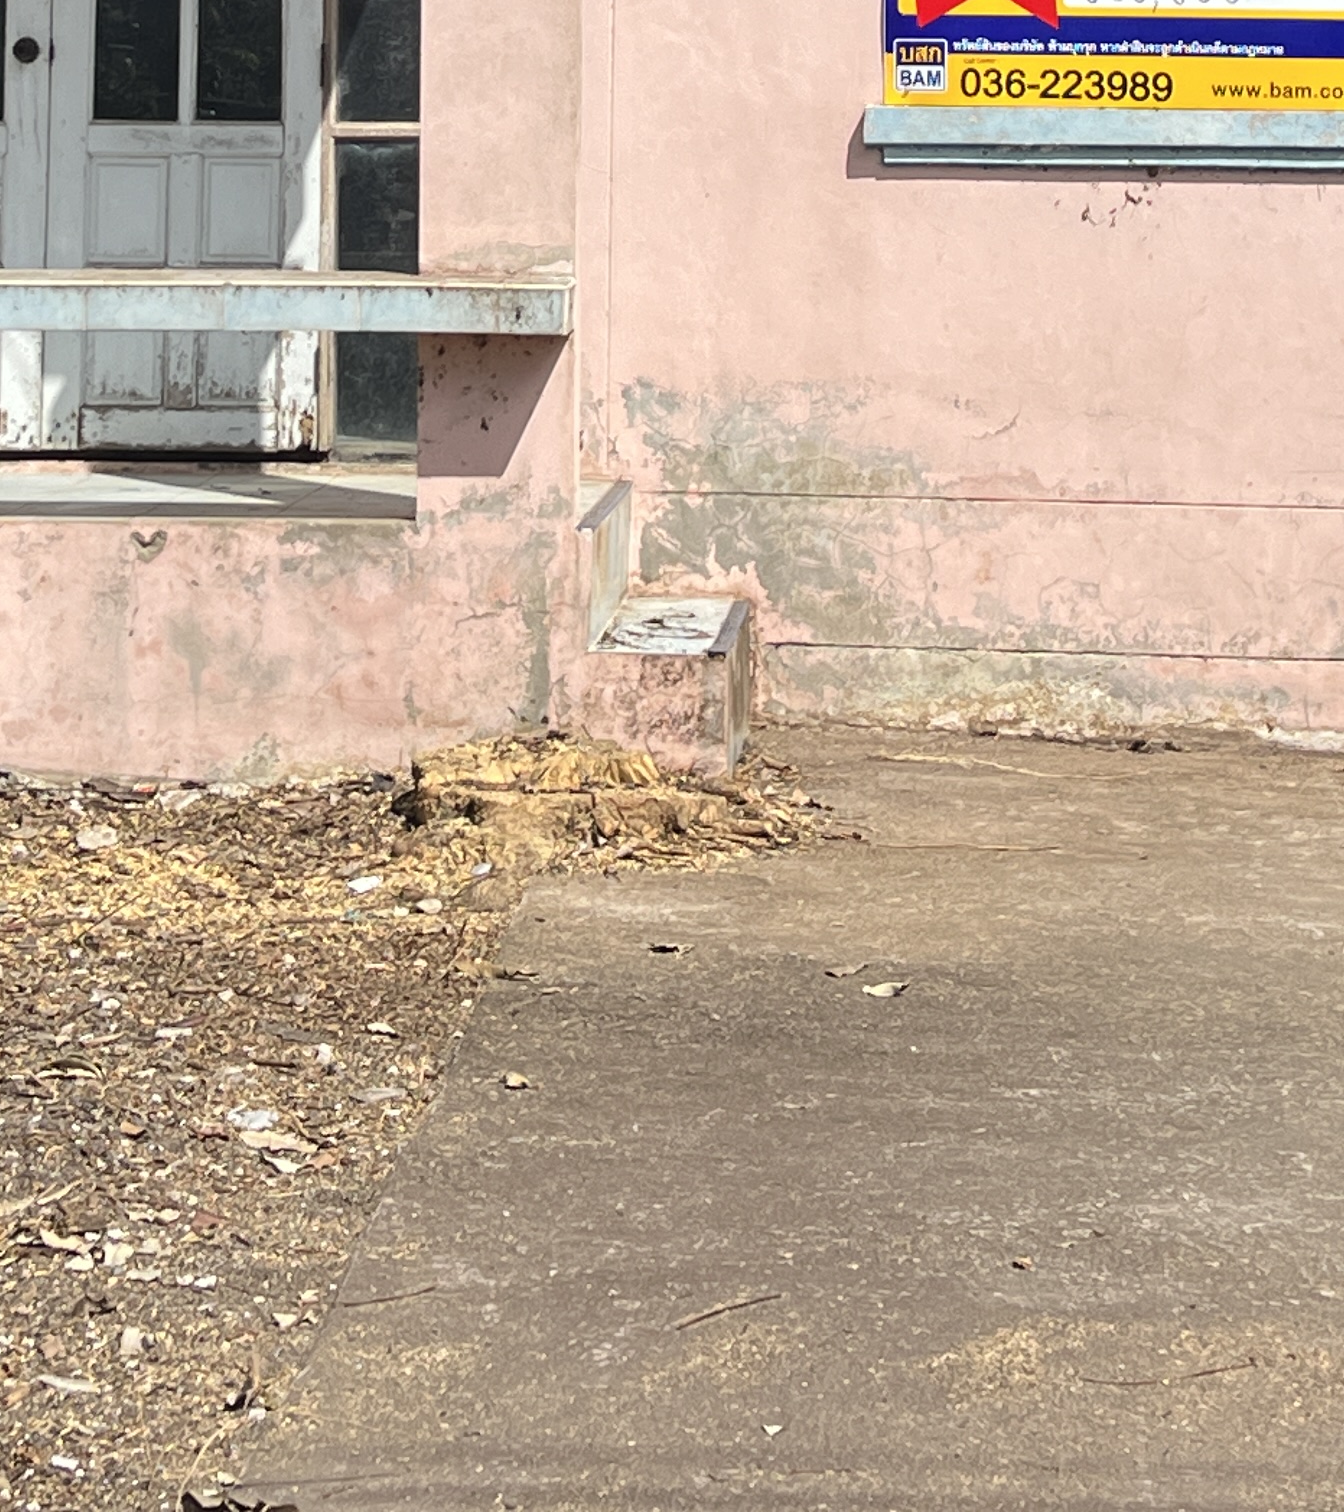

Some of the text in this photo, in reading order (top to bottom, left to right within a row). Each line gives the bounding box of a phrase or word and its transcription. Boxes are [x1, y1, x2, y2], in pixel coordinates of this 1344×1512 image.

[898, 45, 943, 64] บสก
[899, 70, 942, 87] BAM
[960, 67, 1174, 103] 036-223989
